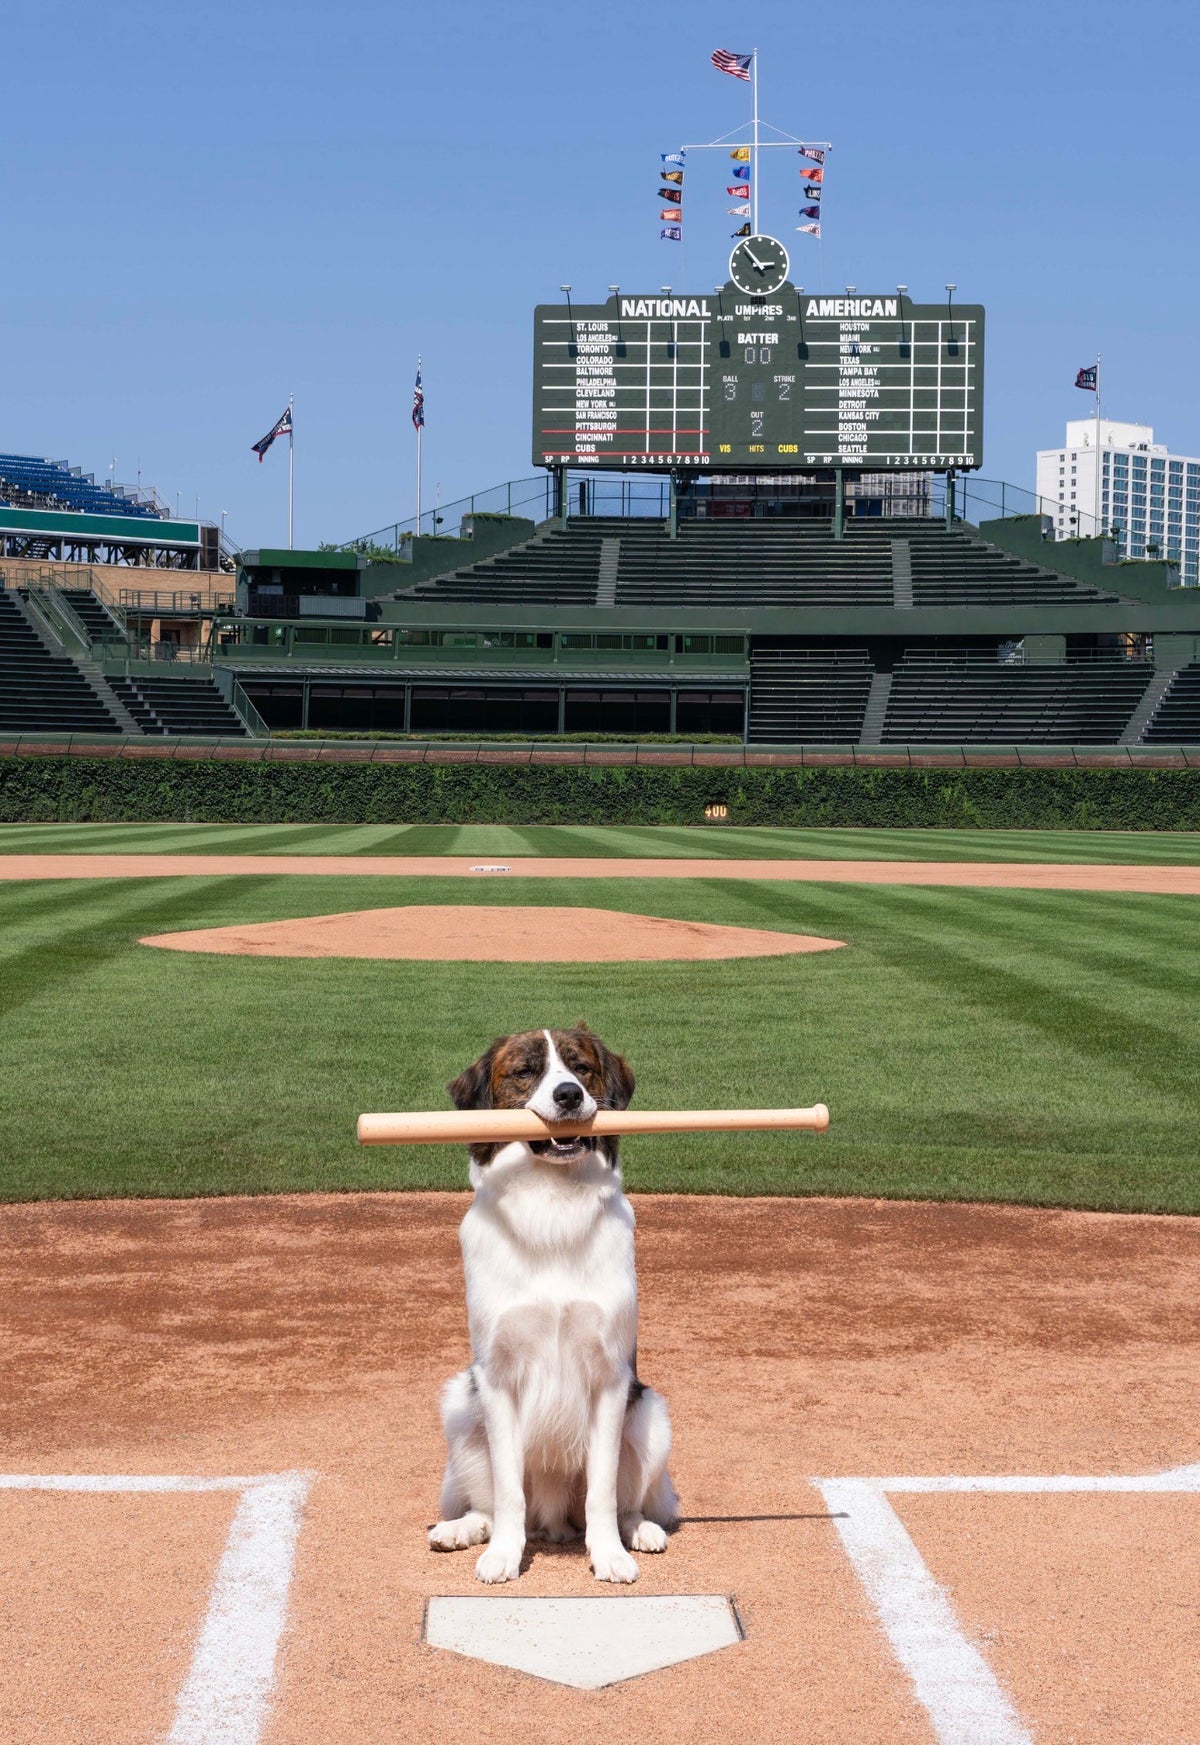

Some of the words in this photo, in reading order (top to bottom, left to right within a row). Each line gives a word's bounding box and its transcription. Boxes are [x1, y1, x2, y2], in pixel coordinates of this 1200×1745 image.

[622, 300, 712, 317] NATIONAL
[735, 305, 783, 316] UMPIRES
[806, 300, 896, 316] AMERICAN
[588, 322, 608, 331] LOUIS
[840, 323, 870, 331] HOUSTON
[576, 334, 588, 342] LOS
[588, 334, 612, 342] ANGELES
[738, 333, 778, 344] BATTER
[840, 334, 860, 342] MIAMI
[576, 345, 609, 354] TORONTO
[840, 346, 854, 354] NEW
[854, 346, 872, 354] YORK
[576, 356, 614, 364] COLORADO
[840, 356, 860, 364] TEXAS
[576, 368, 613, 376] BALTIMORE
[838, 368, 862, 376] TAMPA
[864, 368, 878, 376] BAY
[576, 378, 616, 386] PHILADELPHIA
[838, 378, 850, 386] LOS
[850, 378, 874, 386] ANGELES
[576, 389, 616, 398] CLEVELAND
[725, 384, 736, 400] 3
[779, 384, 790, 400] 2
[838, 390, 880, 398] MINNESOTA
[576, 400, 590, 408] NEW
[590, 400, 608, 408] YORK
[838, 400, 866, 408] DETROIT
[576, 411, 586, 420] SAN
[588, 411, 617, 420] FRANCISCO
[838, 412, 864, 420] KANSAS
[864, 412, 880, 420] CITY
[576, 422, 616, 430] PITTSBURGH
[752, 420, 763, 436] 2
[575, 434, 613, 442] CINCINNATI
[838, 434, 868, 442] CHICAGO
[575, 444, 596, 452] CUBS
[720, 444, 732, 453] VIS
[749, 444, 764, 453] HITS
[778, 444, 798, 453] CUBS
[838, 445, 868, 453] SEATTLE
[623, 456, 626, 464] 1
[631, 456, 636, 464] 2
[641, 456, 646, 464] 3
[649, 456, 654, 464] 4
[658, 456, 663, 464] 5
[667, 456, 672, 464] 6
[676, 456, 682, 464] 7
[684, 456, 690, 464] 8
[694, 456, 699, 464] 9
[701, 456, 710, 464] 10
[705, 804, 726, 817] 400
